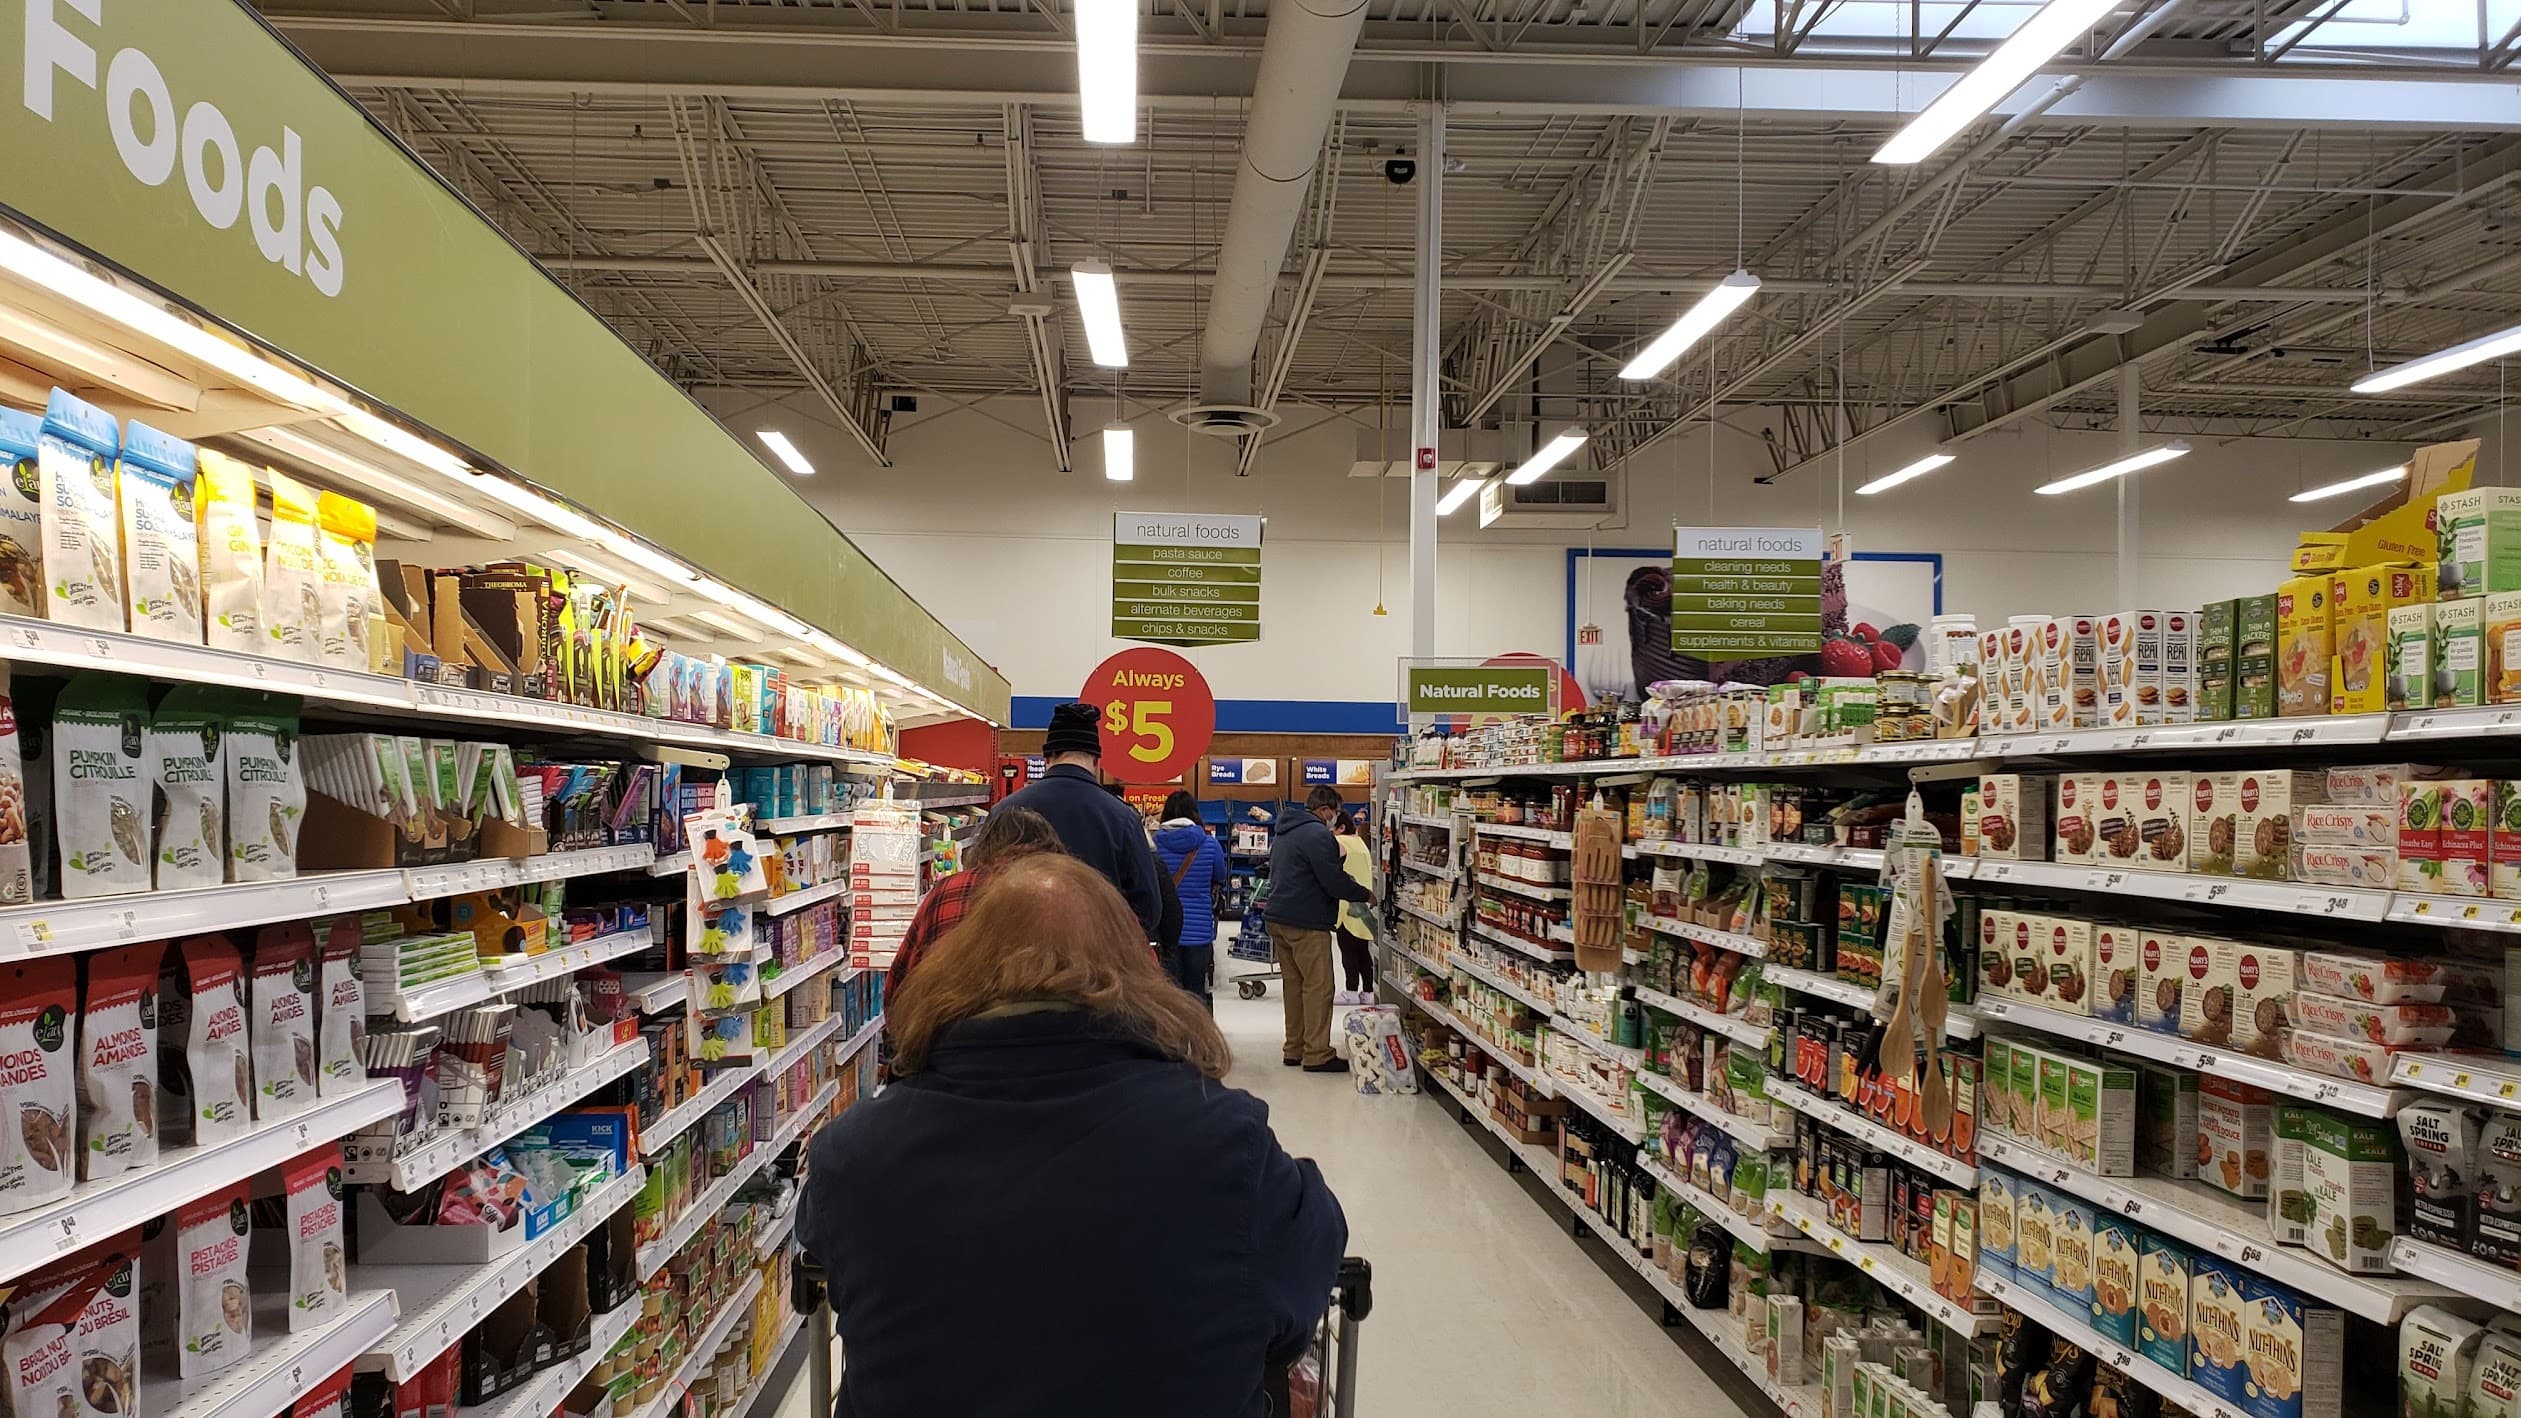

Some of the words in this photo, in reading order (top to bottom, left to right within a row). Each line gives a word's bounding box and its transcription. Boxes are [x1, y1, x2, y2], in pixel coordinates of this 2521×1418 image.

[24, 0, 344, 298] Foods
[2450, 496, 2481, 510] STASH
[2498, 495, 2521, 504] STAS
[1137, 523, 1190, 538] natural
[1196, 523, 1240, 540] foods
[1698, 537, 1752, 551] natural
[1757, 537, 1802, 552] foods
[2378, 539, 2405, 553] Gluten
[2407, 545, 2426, 557] Free
[1152, 548, 1185, 560] pasta
[1187, 549, 1223, 560] sauce
[1167, 567, 1203, 579] coffee
[1704, 562, 1752, 574] cleaning
[1755, 562, 1791, 574] needs
[1152, 585, 1177, 597] bulk
[1179, 586, 1220, 598] snacks
[1702, 579, 1739, 591] health
[1741, 579, 1750, 591] &
[1753, 580, 1792, 593] beauty
[1130, 604, 1180, 616] alternate
[1183, 605, 1242, 619] beverages
[1707, 598, 1747, 612] baking
[1749, 599, 1785, 610] needs
[2398, 612, 2422, 624] STASH
[2447, 607, 2475, 620] STASH
[1141, 622, 1172, 635] chips
[1176, 623, 1185, 634] &
[1187, 625, 1228, 636] snacks
[1730, 616, 1766, 628] cereal
[1580, 630, 1600, 644] EXIT
[1679, 634, 1754, 648] supplements
[1758, 635, 1766, 647] &
[1770, 636, 1817, 648] vitamins
[1111, 669, 1185, 690] Always
[1419, 684, 1483, 698] Natural
[1487, 684, 1541, 698] Foods
[1105, 699, 1175, 764] $5
[70, 750, 117, 765] PUMPKIN
[70, 764, 136, 779] CITROUILLE
[2308, 814, 2323, 829] Rice
[2325, 814, 2353, 830] Crisps
[2306, 853, 2322, 868] Rice
[2324, 854, 2350, 870] Crisps
[2307, 963, 2320, 976] Rice
[2320, 966, 2342, 982] Crisps
[2302, 1002, 2317, 1017] Rice
[2318, 1006, 2346, 1023] Crisps
[94, 1027, 142, 1053] ALMONDS
[93, 1041, 147, 1068] AMANDES
[2295, 1042, 2310, 1058] Rice
[2311, 1046, 2336, 1063] Crisps
[2416, 1115, 2440, 1130] SALT
[2409, 1125, 2449, 1143] SPRING
[2504, 1126, 2521, 1139] SAL
[2305, 1151, 2322, 1168] KALE
[2319, 1185, 2337, 1201] KALE
[2248, 1328, 2297, 1373] NUT-THINS
[2421, 1340, 2444, 1357] SALT
